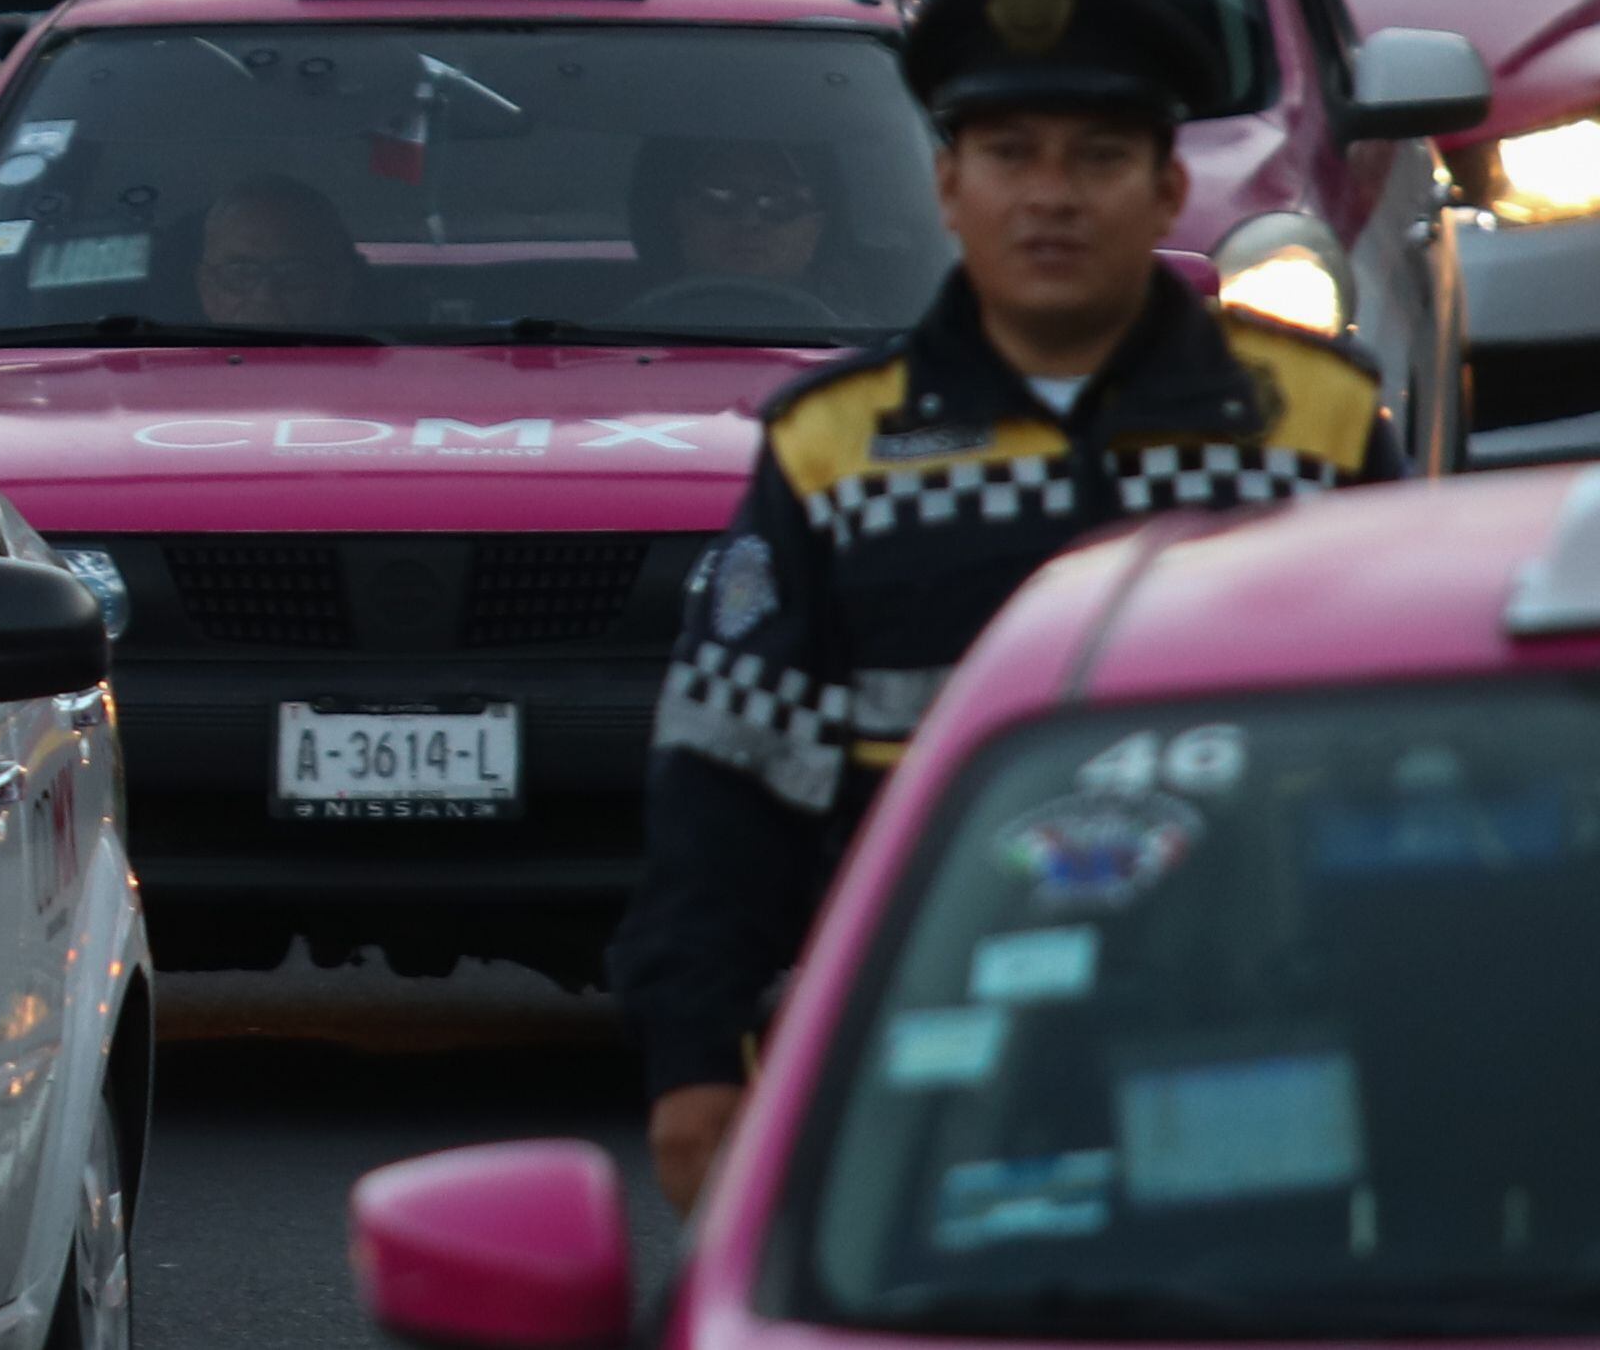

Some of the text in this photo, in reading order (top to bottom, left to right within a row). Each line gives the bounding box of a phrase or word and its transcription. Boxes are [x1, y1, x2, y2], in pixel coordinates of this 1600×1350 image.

[133, 417, 699, 450] CDMX
[297, 729, 498, 781] A-3614-L
[323, 801, 468, 818] NISSAN
